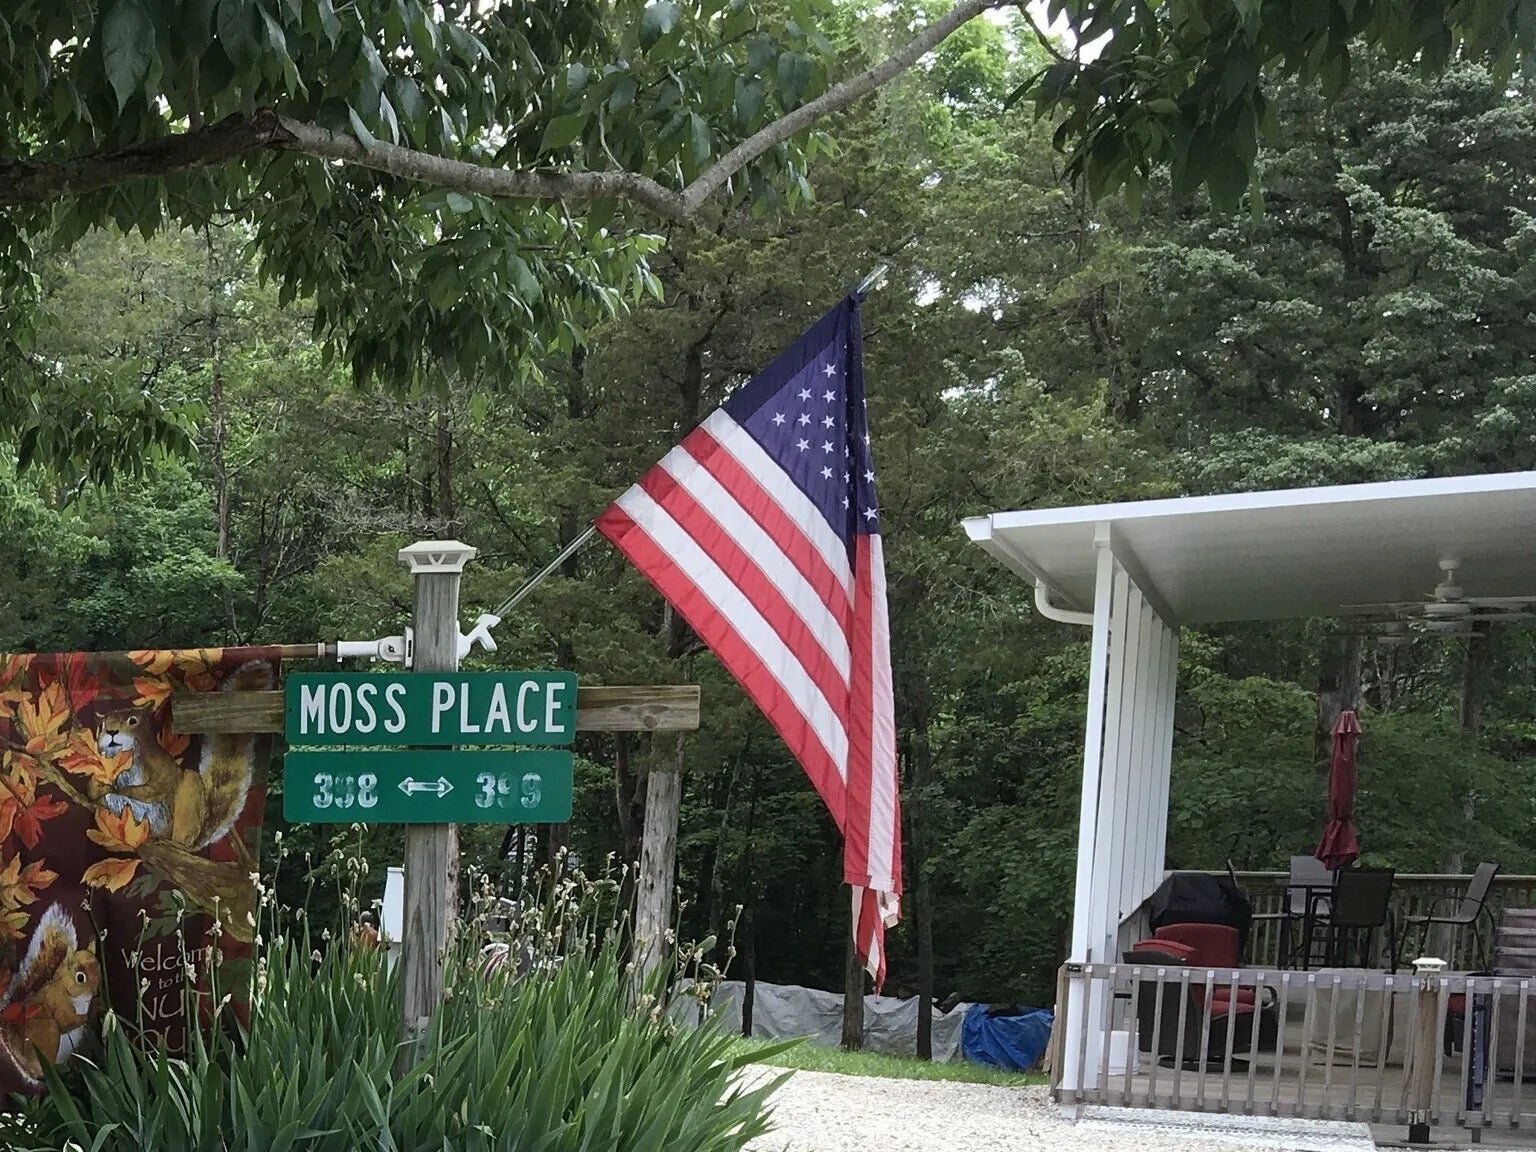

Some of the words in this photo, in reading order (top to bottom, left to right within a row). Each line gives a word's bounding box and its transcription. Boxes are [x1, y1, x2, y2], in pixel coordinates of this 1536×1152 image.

[299, 682, 408, 735] MOSS
[431, 680, 566, 734] PLACE
[121, 944, 211, 971] Welcom
[158, 977, 173, 990] to
